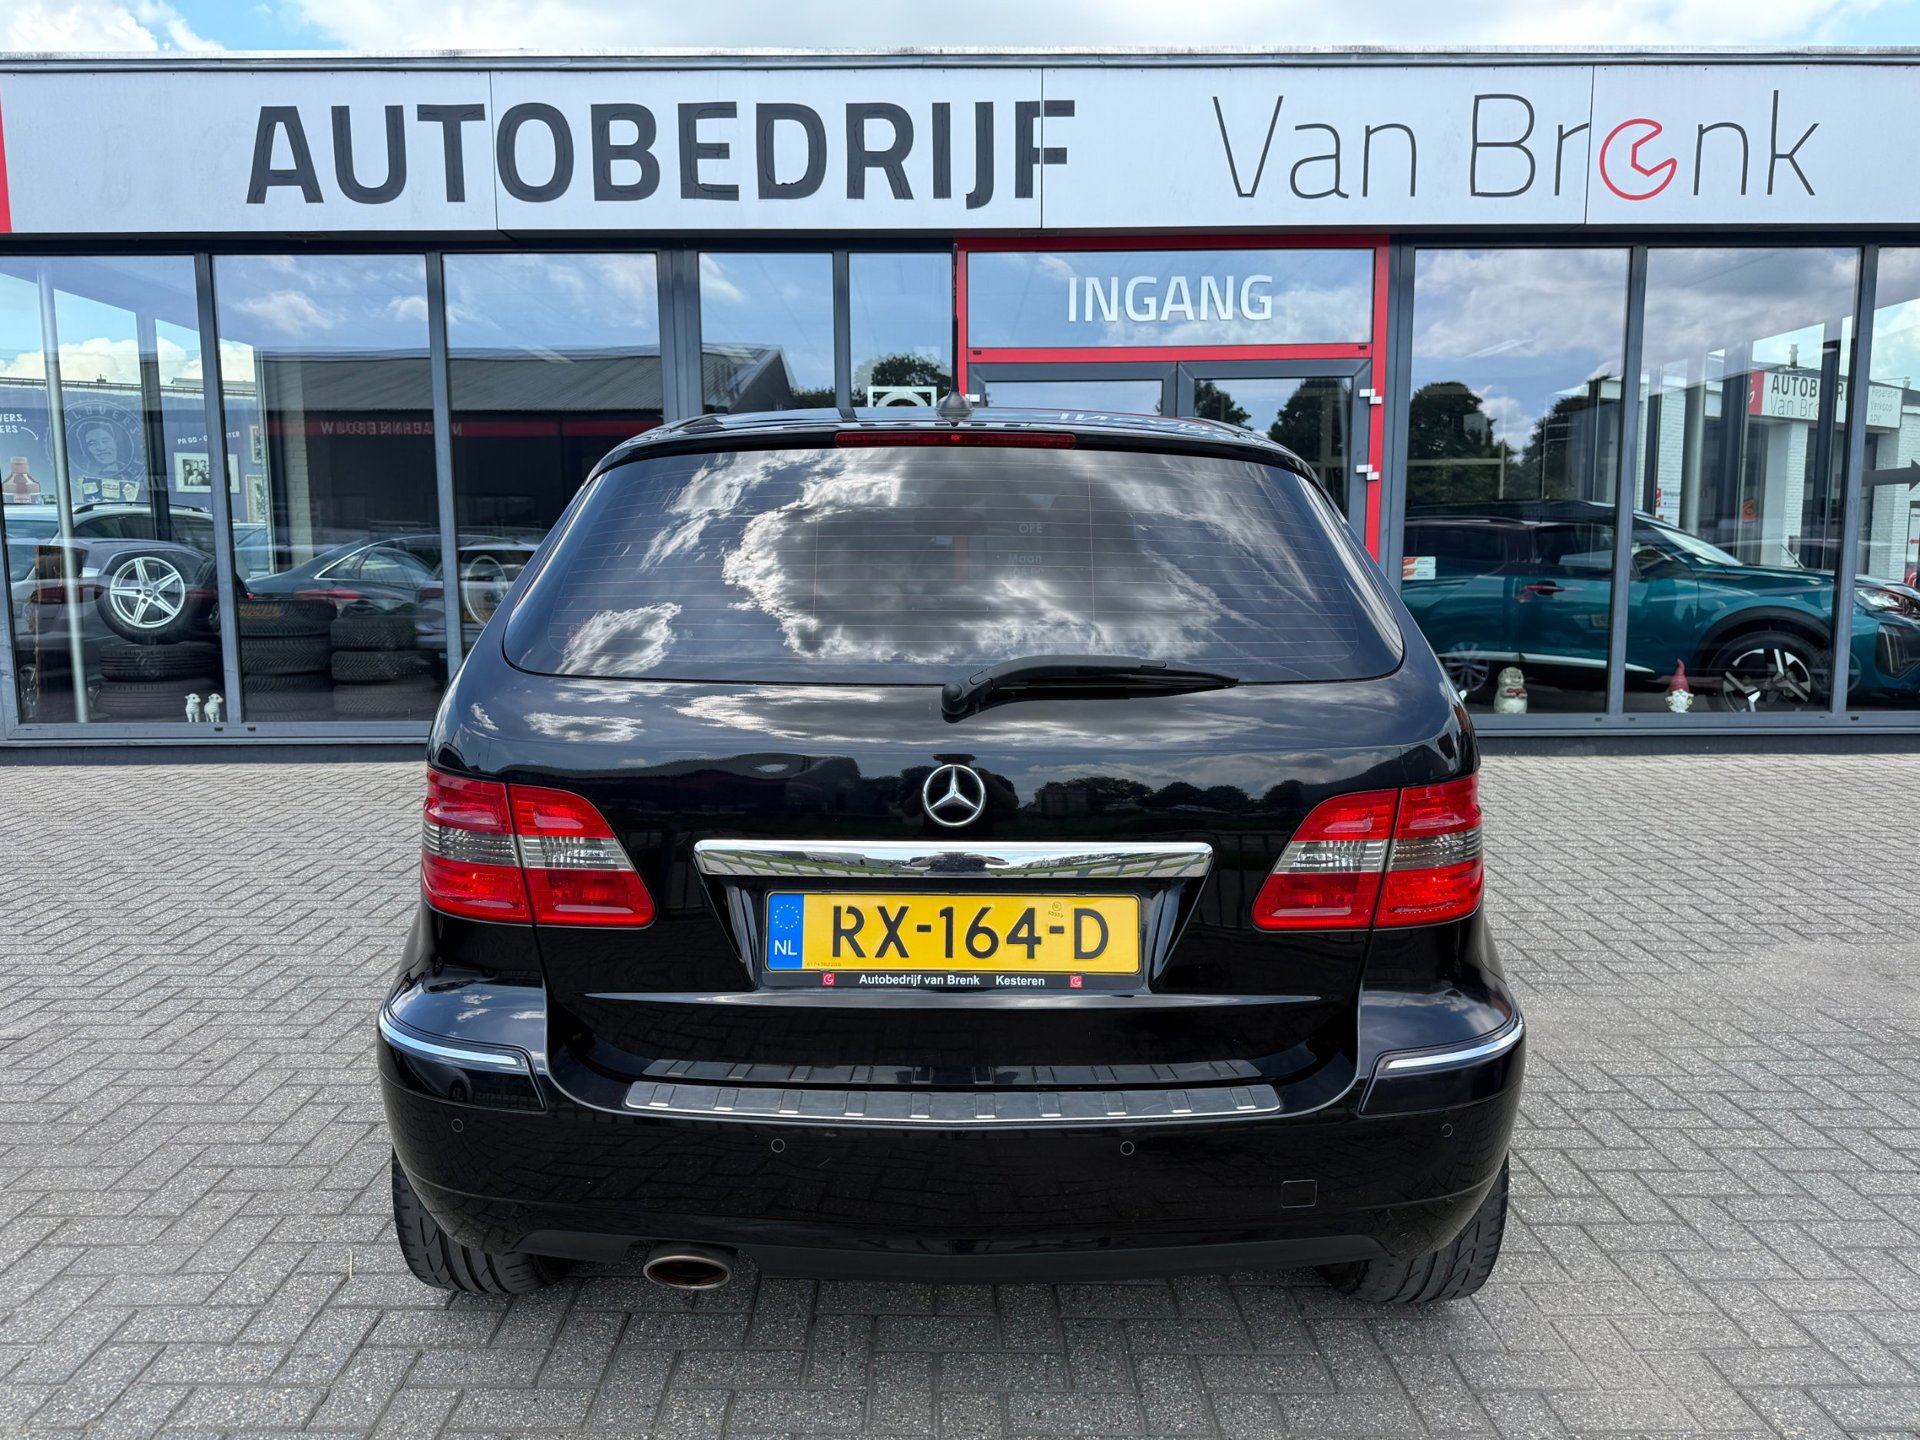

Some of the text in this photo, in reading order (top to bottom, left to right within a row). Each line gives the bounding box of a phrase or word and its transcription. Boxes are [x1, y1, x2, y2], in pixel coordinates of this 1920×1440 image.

[246, 100, 1075, 209] AUTOBEDRIJF
[1212, 95, 1416, 199] Van
[1068, 275, 1272, 322] INGANG
[774, 940, 797, 956] NL
[832, 905, 1109, 960] RX-164-D
[859, 974, 1046, 987] Autobedrijf van Brenk Kesteren
